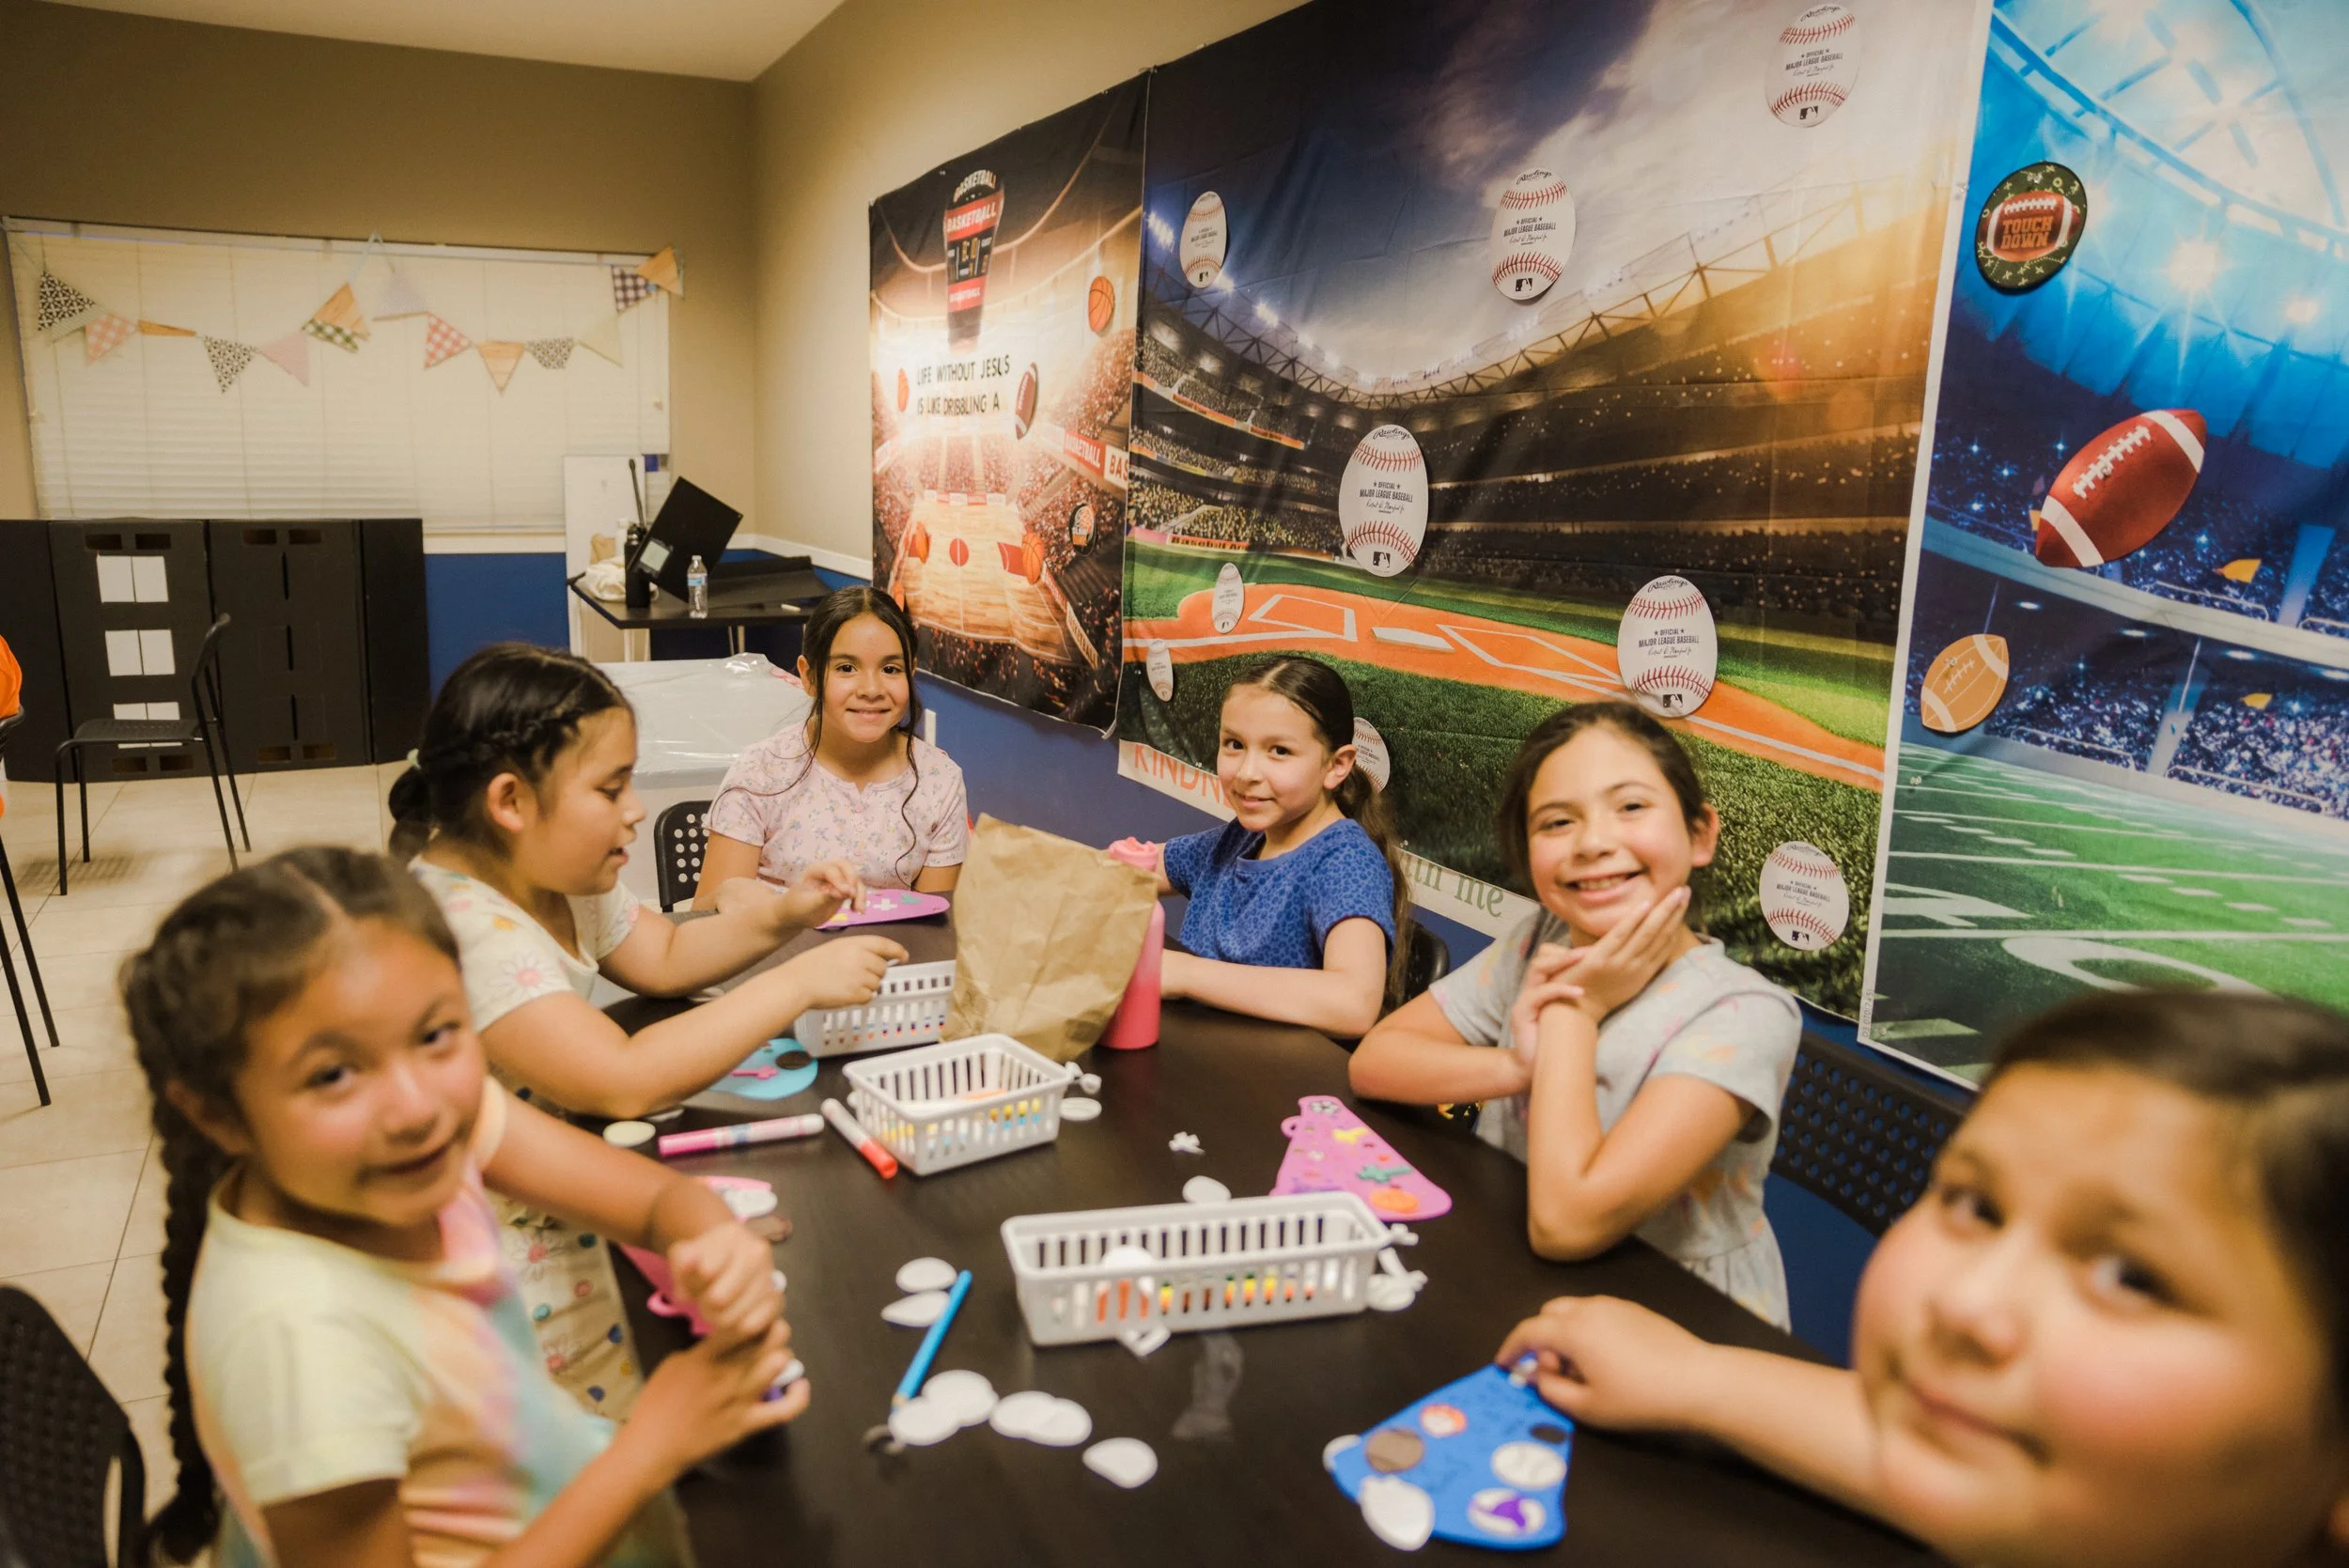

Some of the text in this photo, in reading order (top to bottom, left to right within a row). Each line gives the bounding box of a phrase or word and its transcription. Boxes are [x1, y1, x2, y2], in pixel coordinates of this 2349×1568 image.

[1785, 60, 1802, 70] MAJOR
[1803, 56, 1820, 67] LEAGUE
[1821, 53, 1843, 63] BASEBALL
[1520, 217, 1537, 225] OFFICIAL
[2002, 216, 2054, 235] TOUCH
[1503, 222, 1557, 237] MAJOR LEAGUE BASEBALL
[2000, 231, 2049, 249] DOWN
[937, 361, 975, 383] WITHOUT
[942, 394, 988, 416] DRIBBLING
[992, 391, 1001, 411] A
[1373, 427, 1411, 441] Rawlings
[1377, 481, 1395, 489] OFFICIAL
[1359, 489, 1414, 504] MAJOR LEAGUE BASEBALL
[1647, 578, 1689, 593] Rawlings
[1659, 628, 1679, 636] OFFICIAL
[1638, 635, 1700, 648] MAJOR LEAGUE BASEBALL
[1454, 873, 1504, 917] me
[1776, 883, 1792, 892] MAJOR
[1792, 886, 1809, 896] LEAGUE
[1809, 890, 1830, 903] BASEBALL
